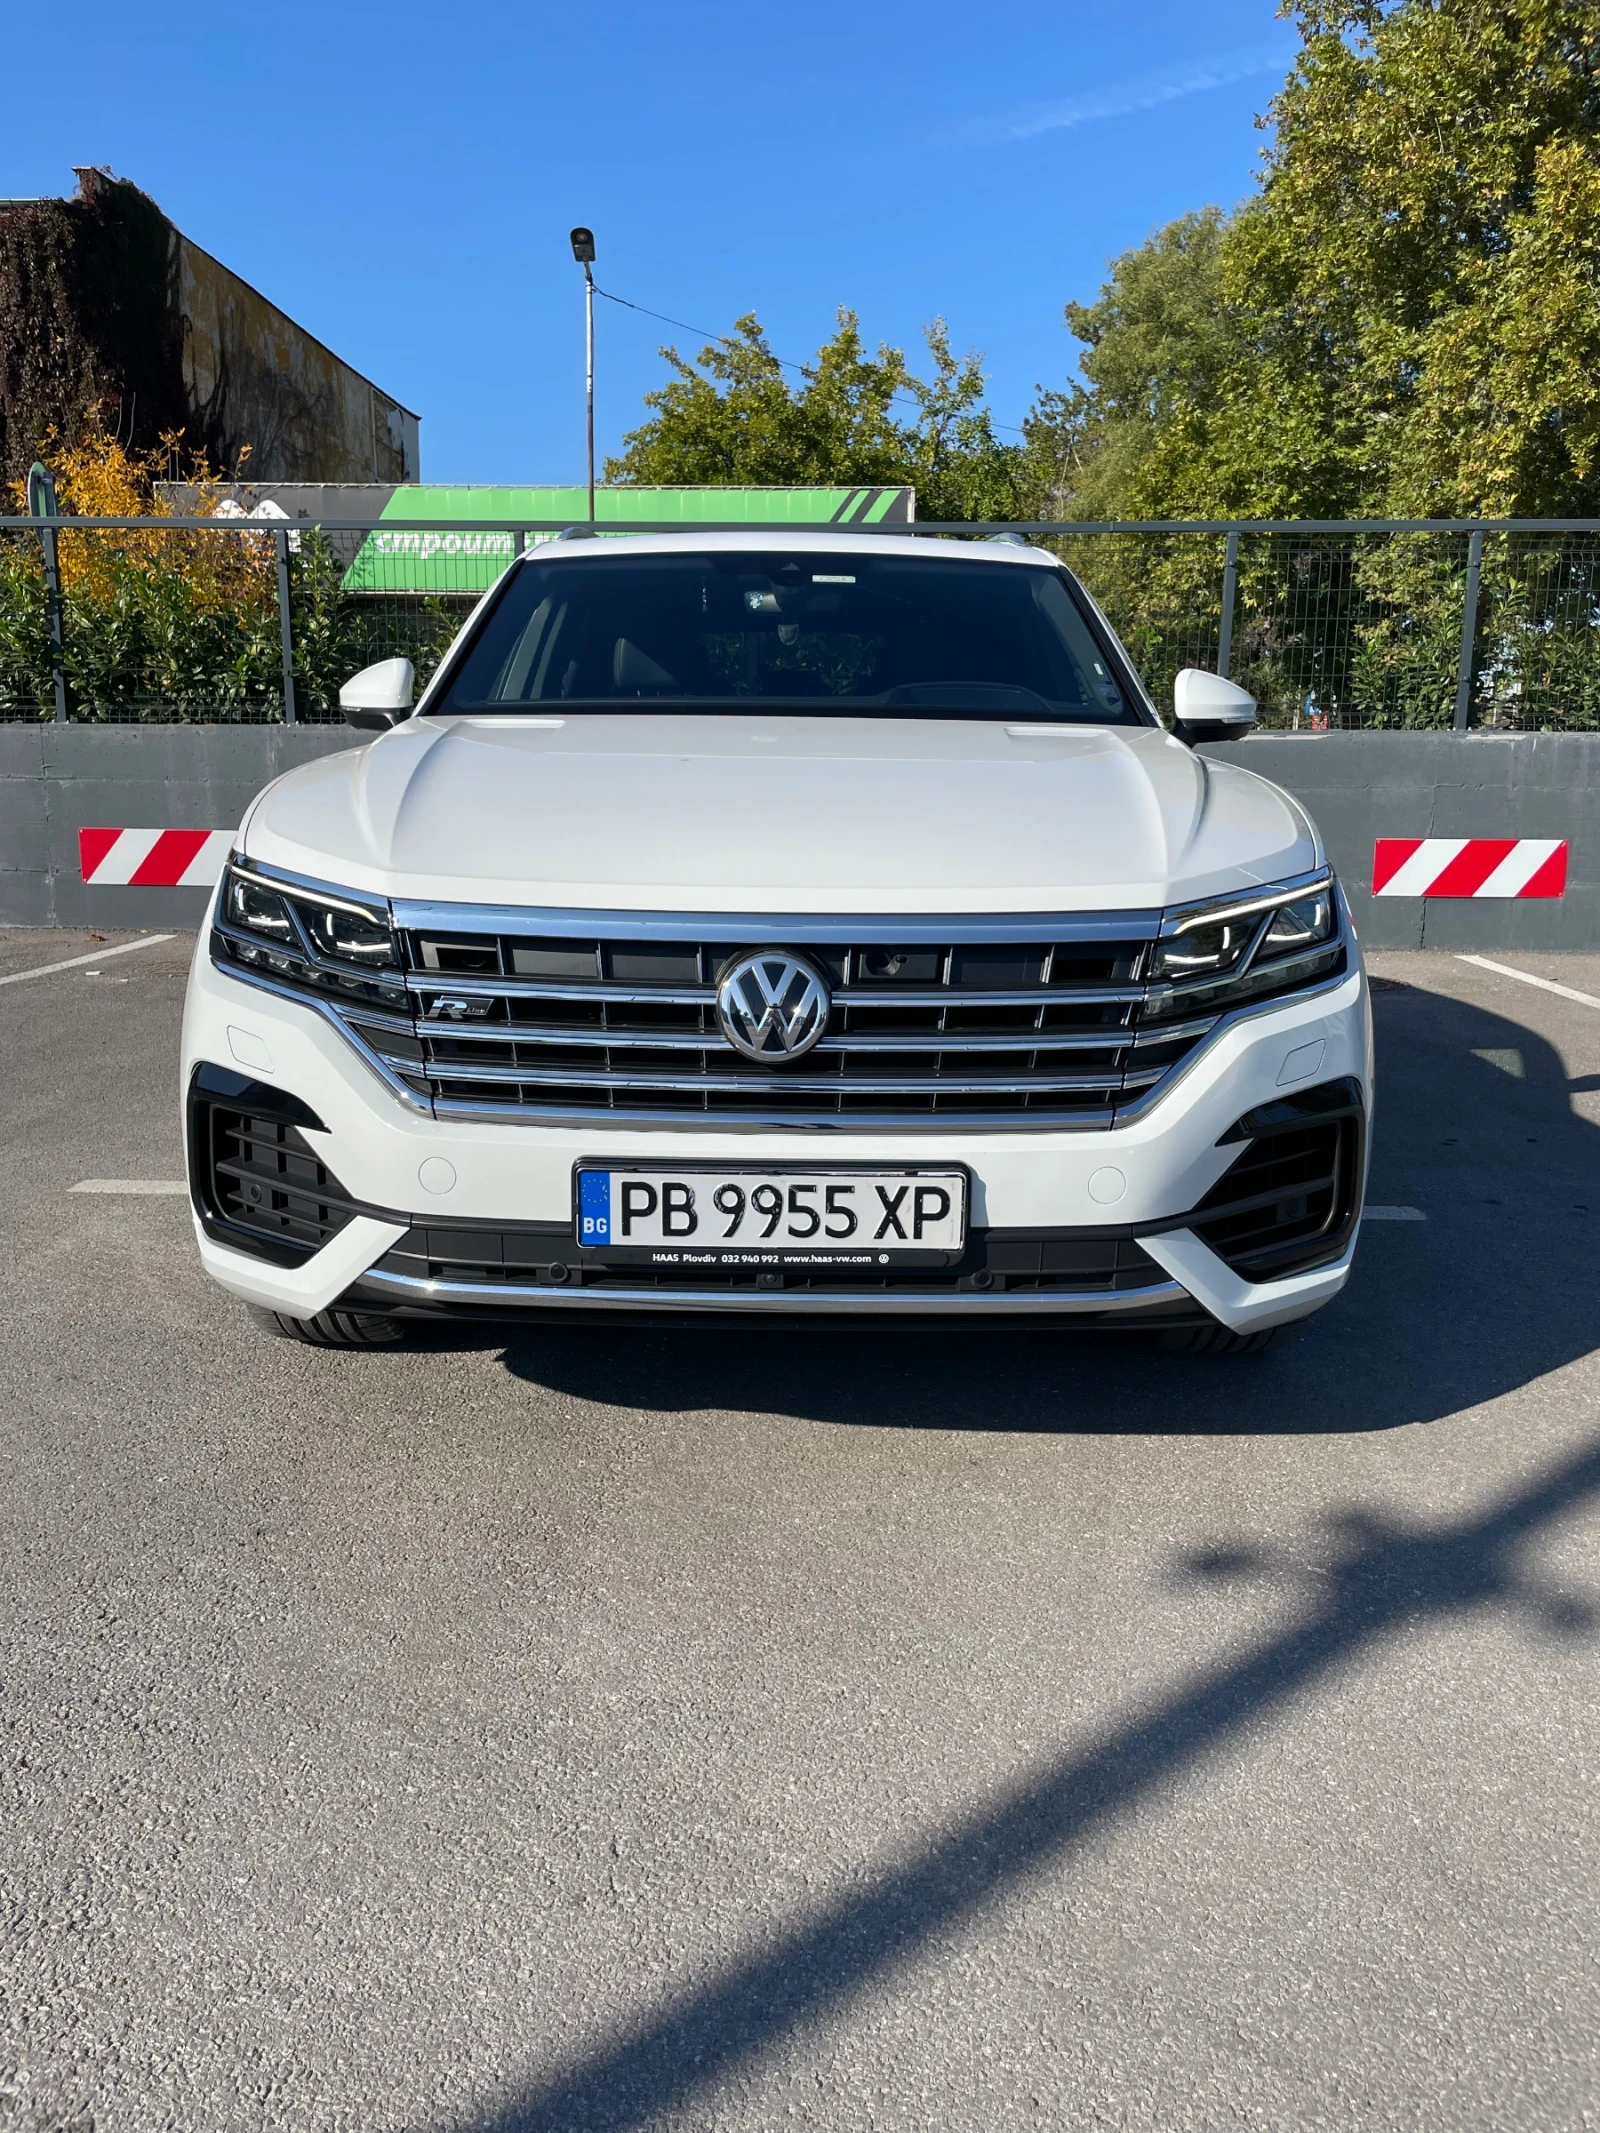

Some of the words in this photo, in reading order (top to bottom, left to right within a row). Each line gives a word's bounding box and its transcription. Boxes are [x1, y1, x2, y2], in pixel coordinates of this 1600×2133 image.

[428, 1000, 467, 1019] R
[583, 1217, 607, 1234] BG
[621, 1181, 698, 1236] PB
[713, 1183, 858, 1239] 9955
[873, 1185, 950, 1240] XP
[652, 1253, 679, 1262] HAAS
[683, 1254, 717, 1263] Plovdiv
[721, 1254, 740, 1263] 032
[741, 1254, 760, 1263] 940
[761, 1254, 779, 1264] 992
[783, 1254, 872, 1263] www.haas-vw.com
